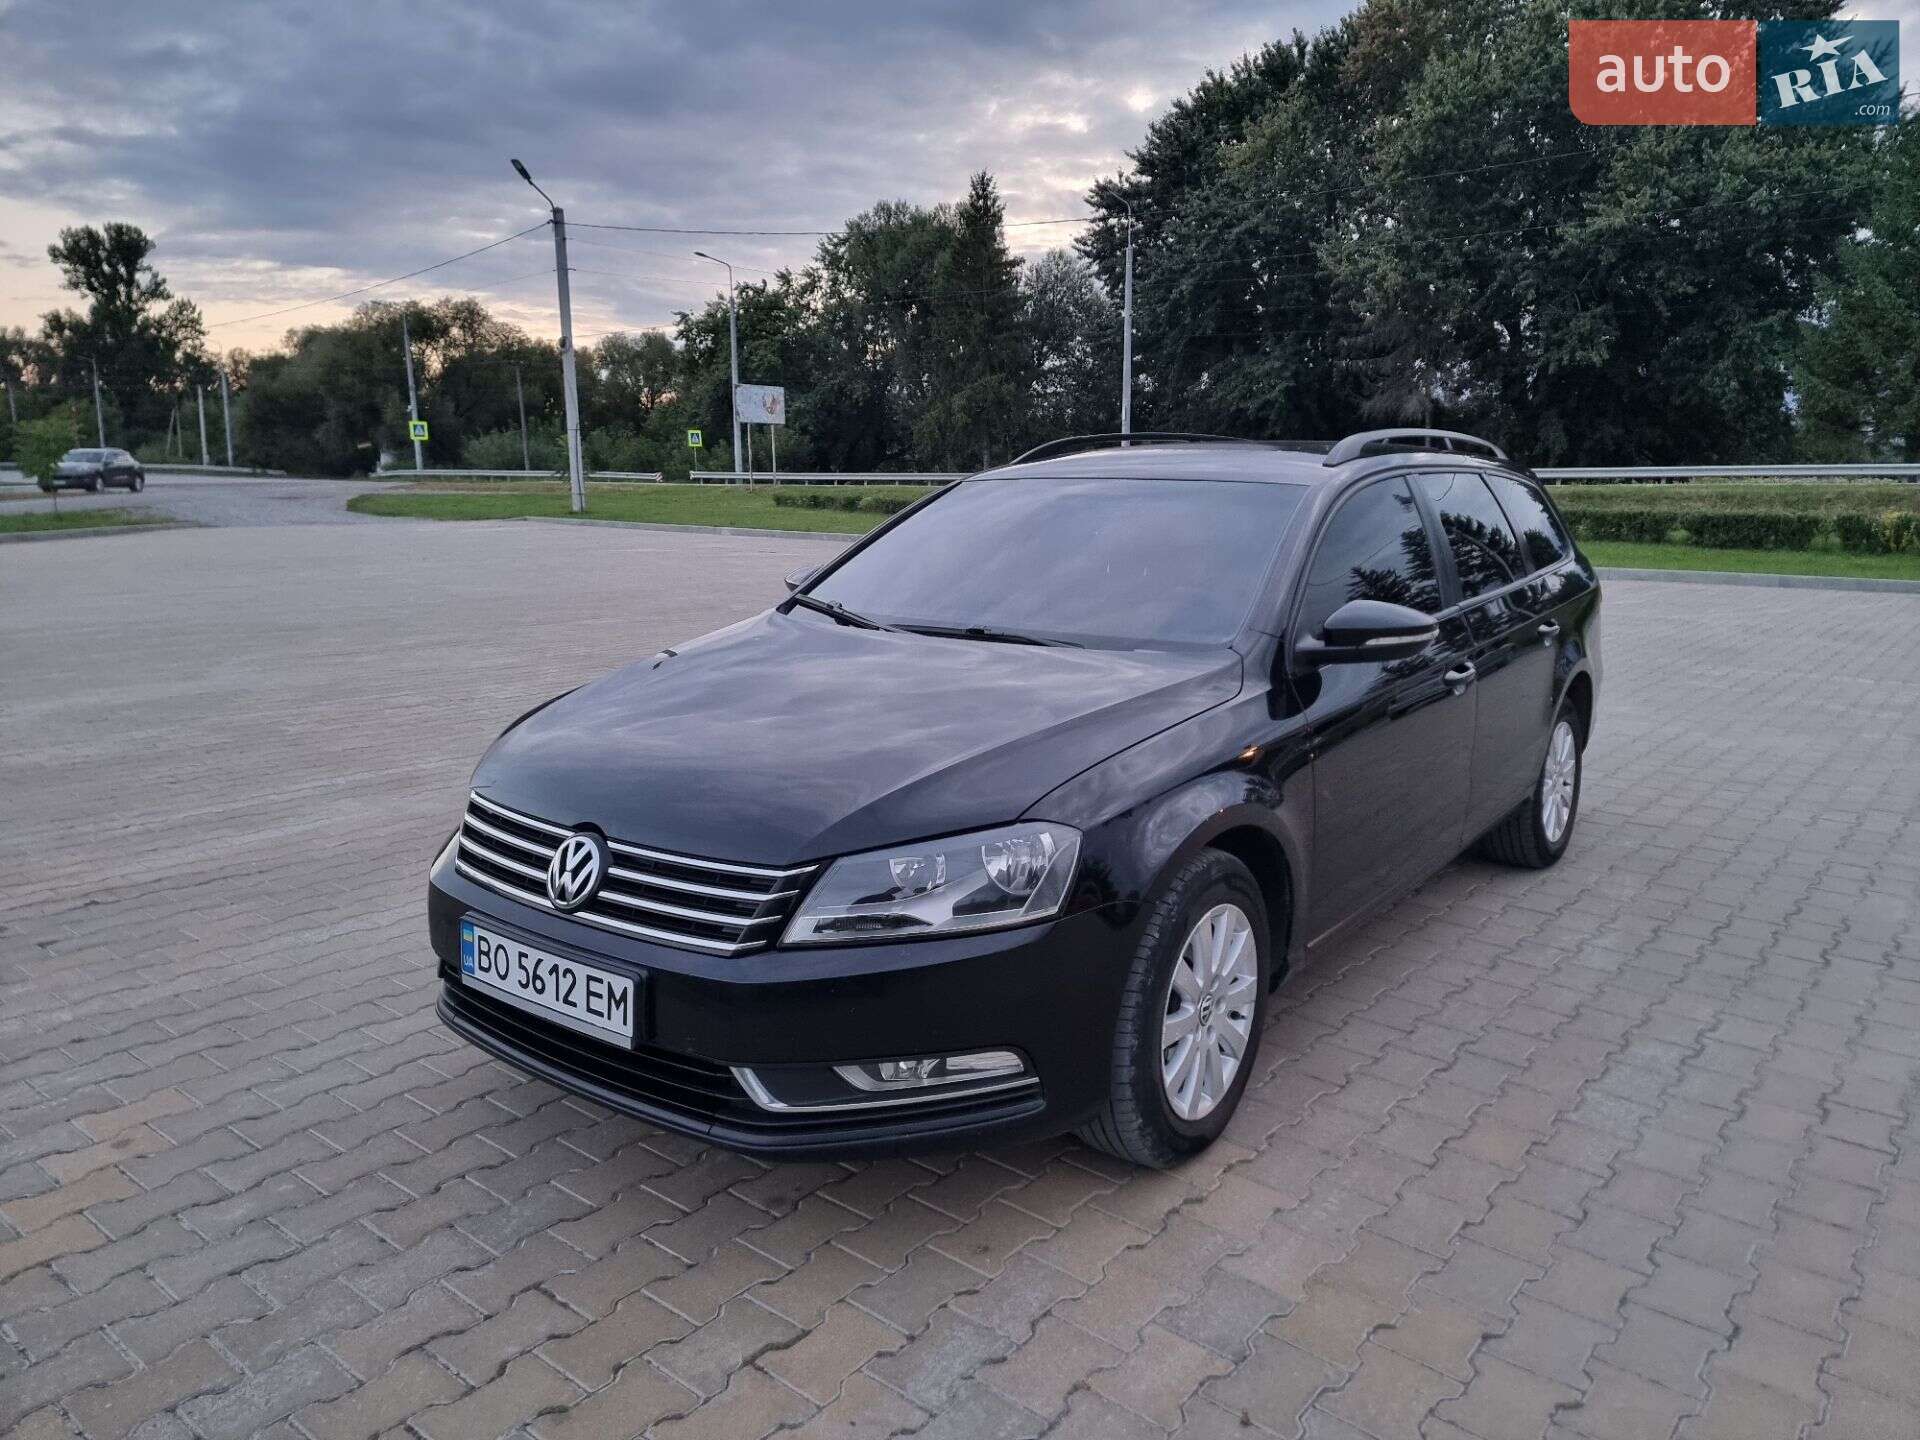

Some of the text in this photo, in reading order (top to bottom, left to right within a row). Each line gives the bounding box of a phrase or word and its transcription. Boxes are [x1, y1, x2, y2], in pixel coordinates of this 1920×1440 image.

[463, 955, 474, 968] UA
[478, 934, 628, 1027] BO 5612 EM
